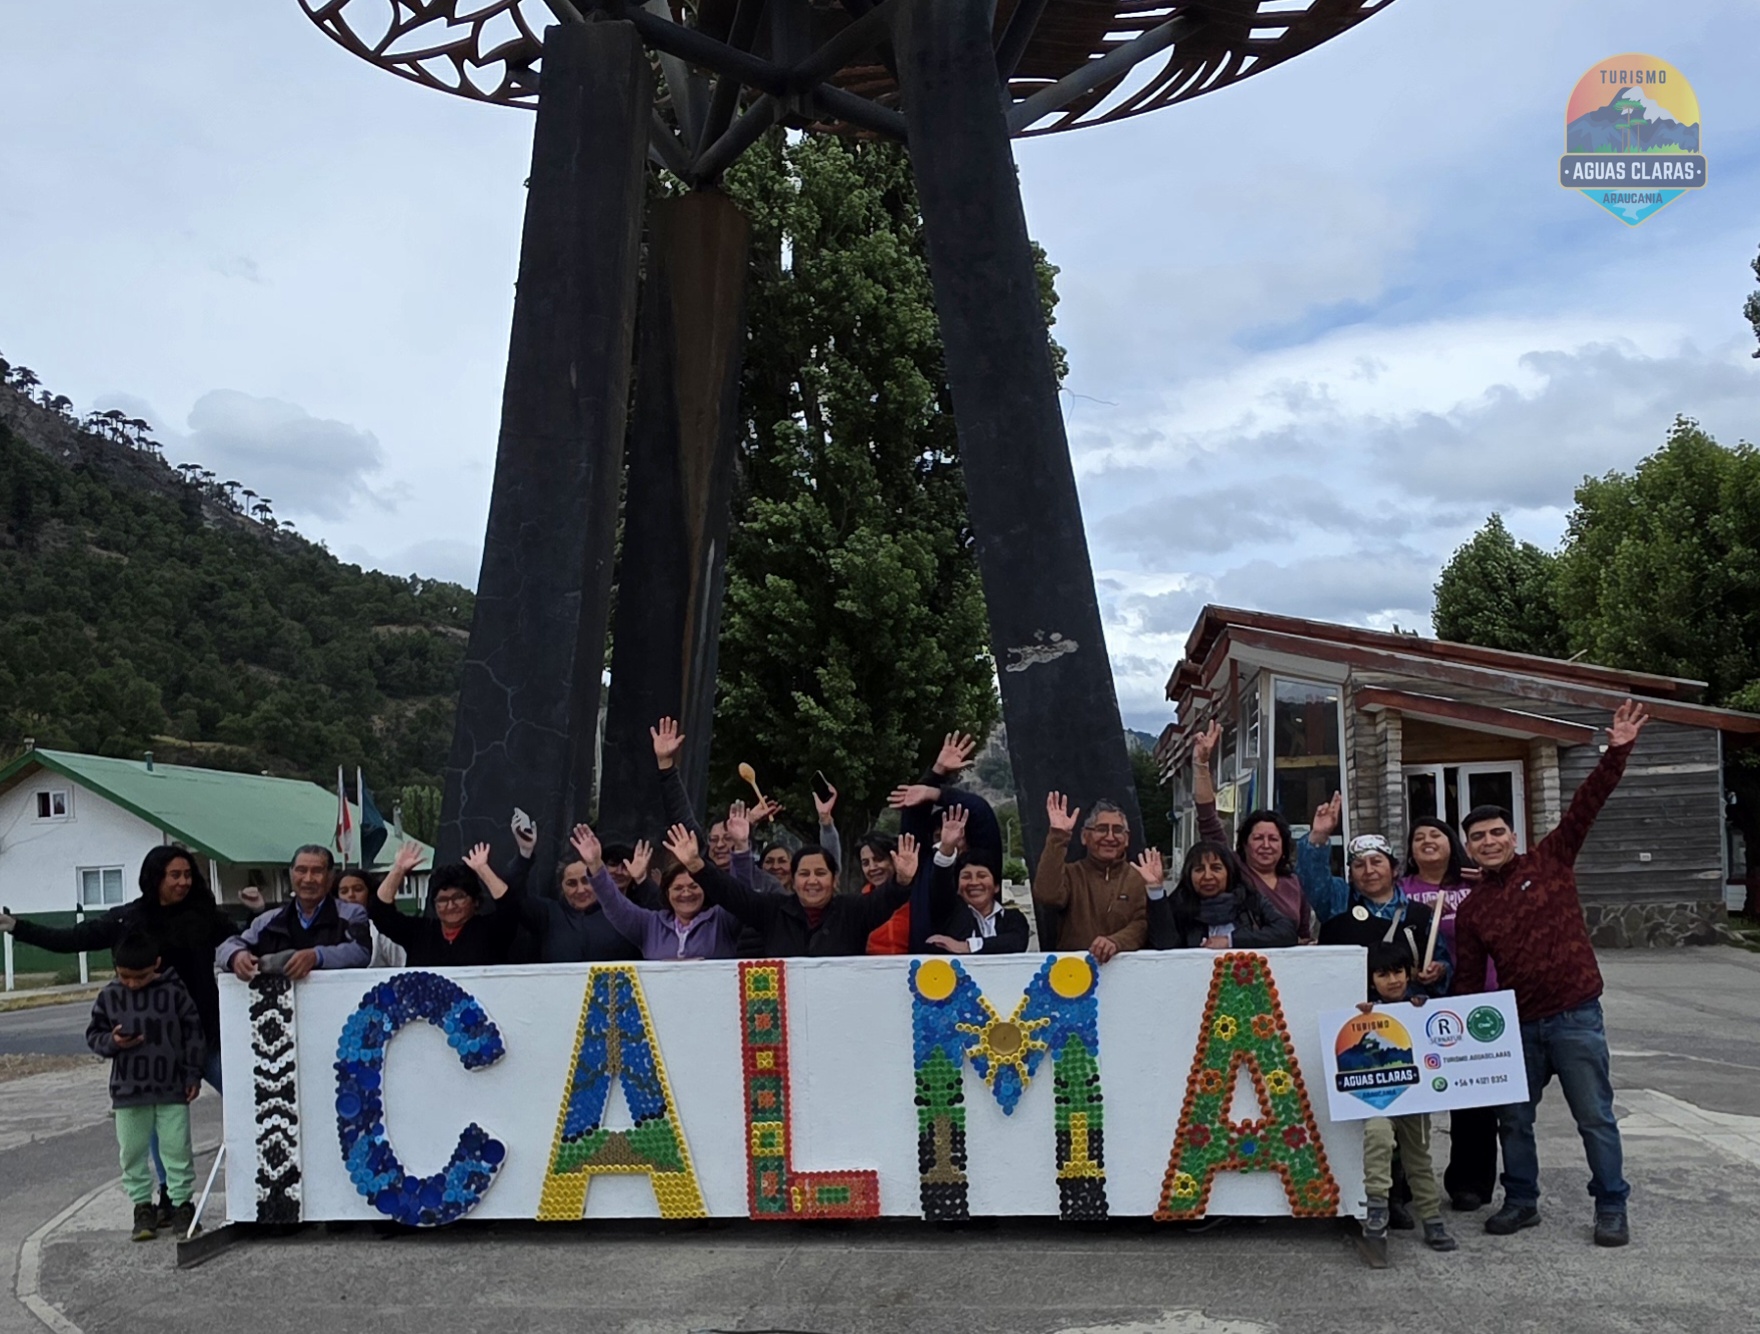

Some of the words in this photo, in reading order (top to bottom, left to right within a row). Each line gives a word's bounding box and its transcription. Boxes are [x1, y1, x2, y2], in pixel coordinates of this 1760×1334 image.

[1351, 1020, 1390, 1032] TURISMO
[1343, 1073, 1375, 1088] AGUAS
[1375, 1069, 1414, 1084] CLARAS
[249, 950, 1341, 1229] ICALMA
